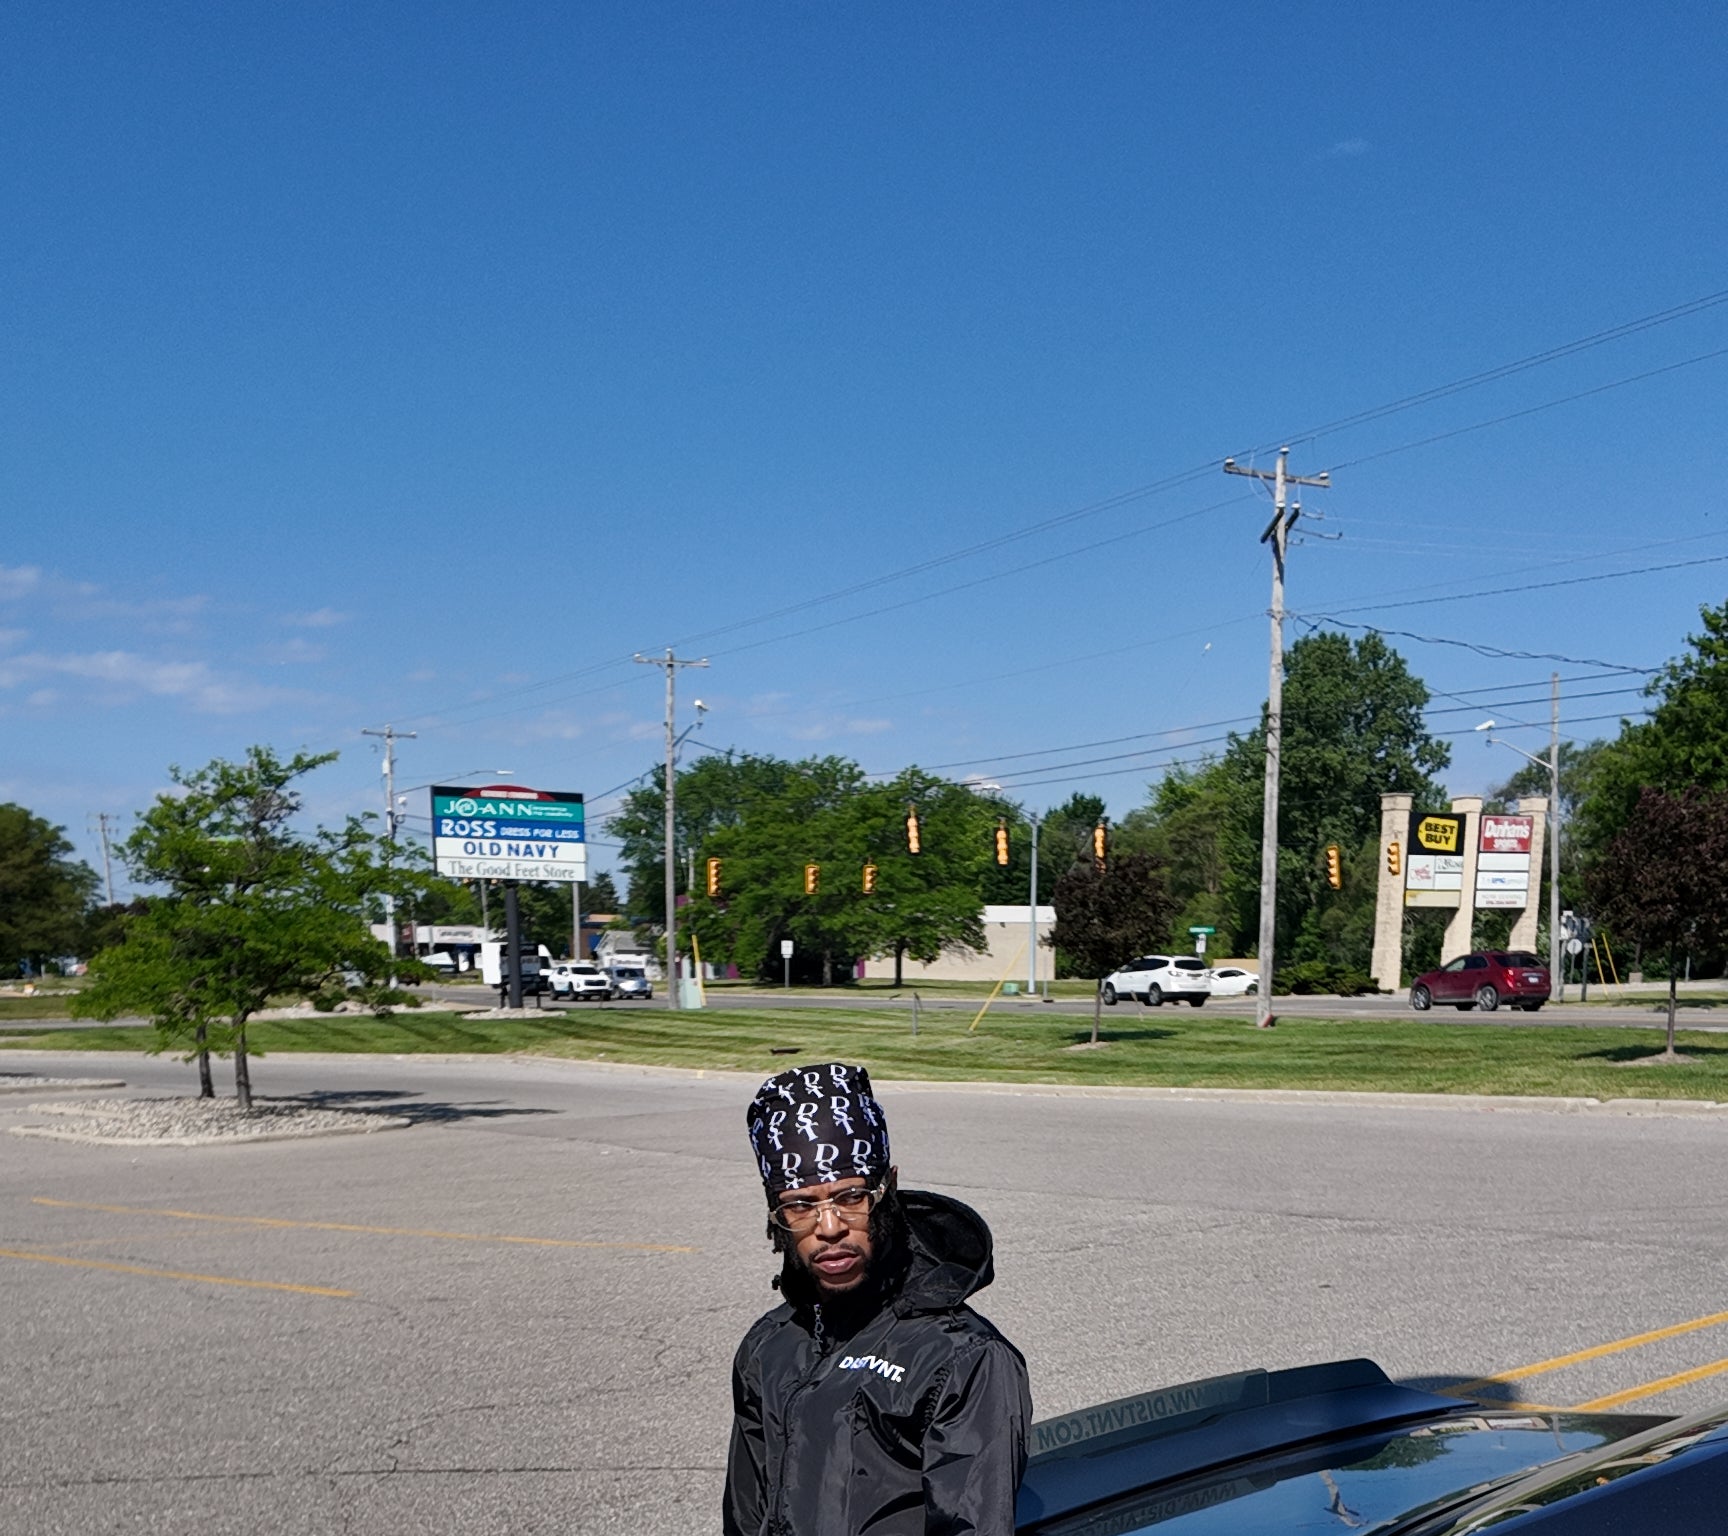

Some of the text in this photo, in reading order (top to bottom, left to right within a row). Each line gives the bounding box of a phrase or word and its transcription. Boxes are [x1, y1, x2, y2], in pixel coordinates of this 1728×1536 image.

[441, 819, 497, 837] ROSS
[1425, 822, 1456, 835] BEST
[1425, 833, 1451, 845] BUY
[463, 841, 559, 858] OLD NAVY
[450, 860, 575, 879] The Good Feet Store
